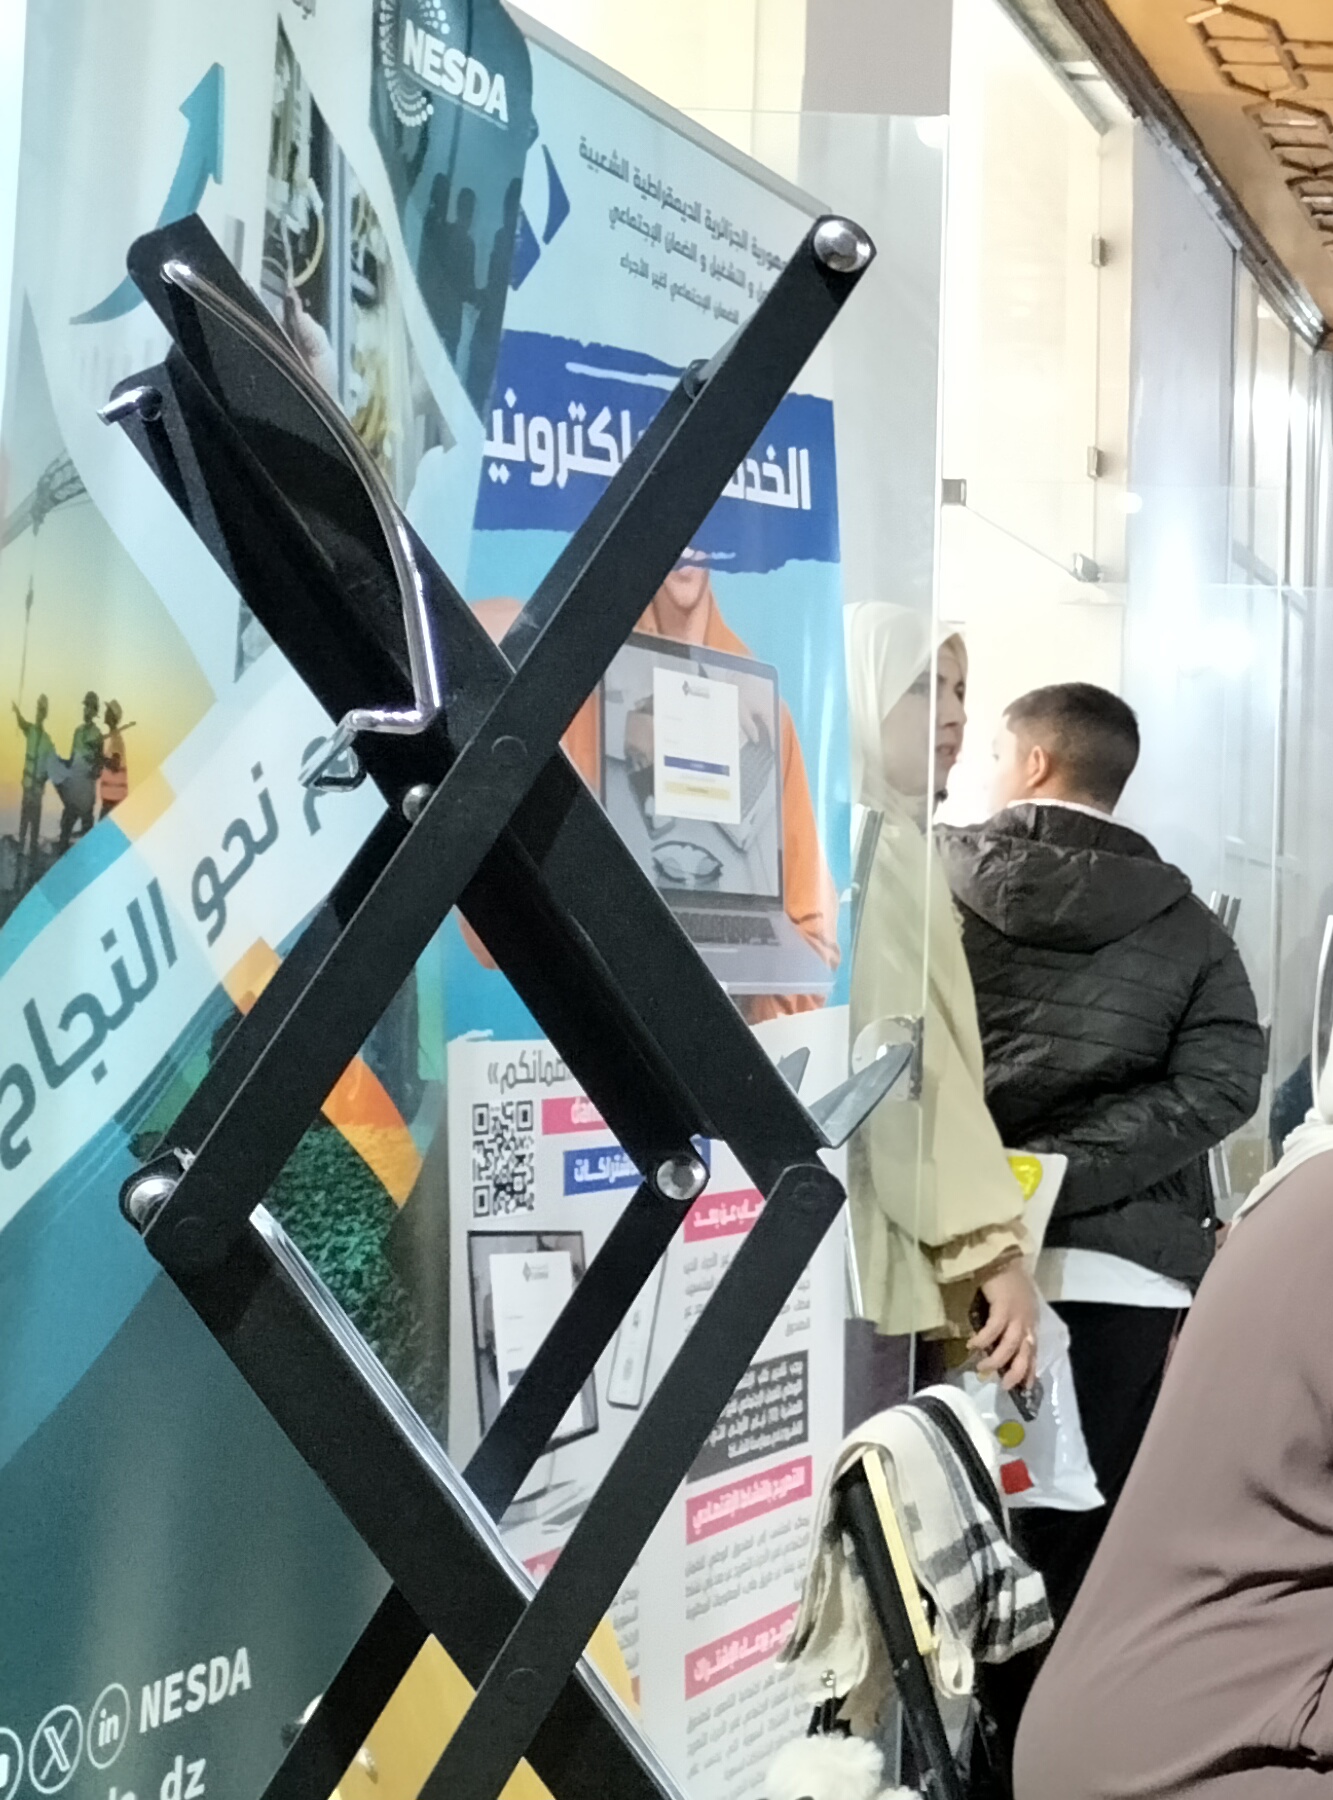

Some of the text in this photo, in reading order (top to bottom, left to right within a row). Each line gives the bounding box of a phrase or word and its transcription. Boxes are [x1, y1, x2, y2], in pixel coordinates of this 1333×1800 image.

[403, 18, 508, 123] NESDA
[578, 135, 630, 183] الشعبية
[633, 166, 702, 225] الديمقراطية
[0, 760, 279, 1171] نحو النجاح
[139, 1646, 252, 1733] NESDA
